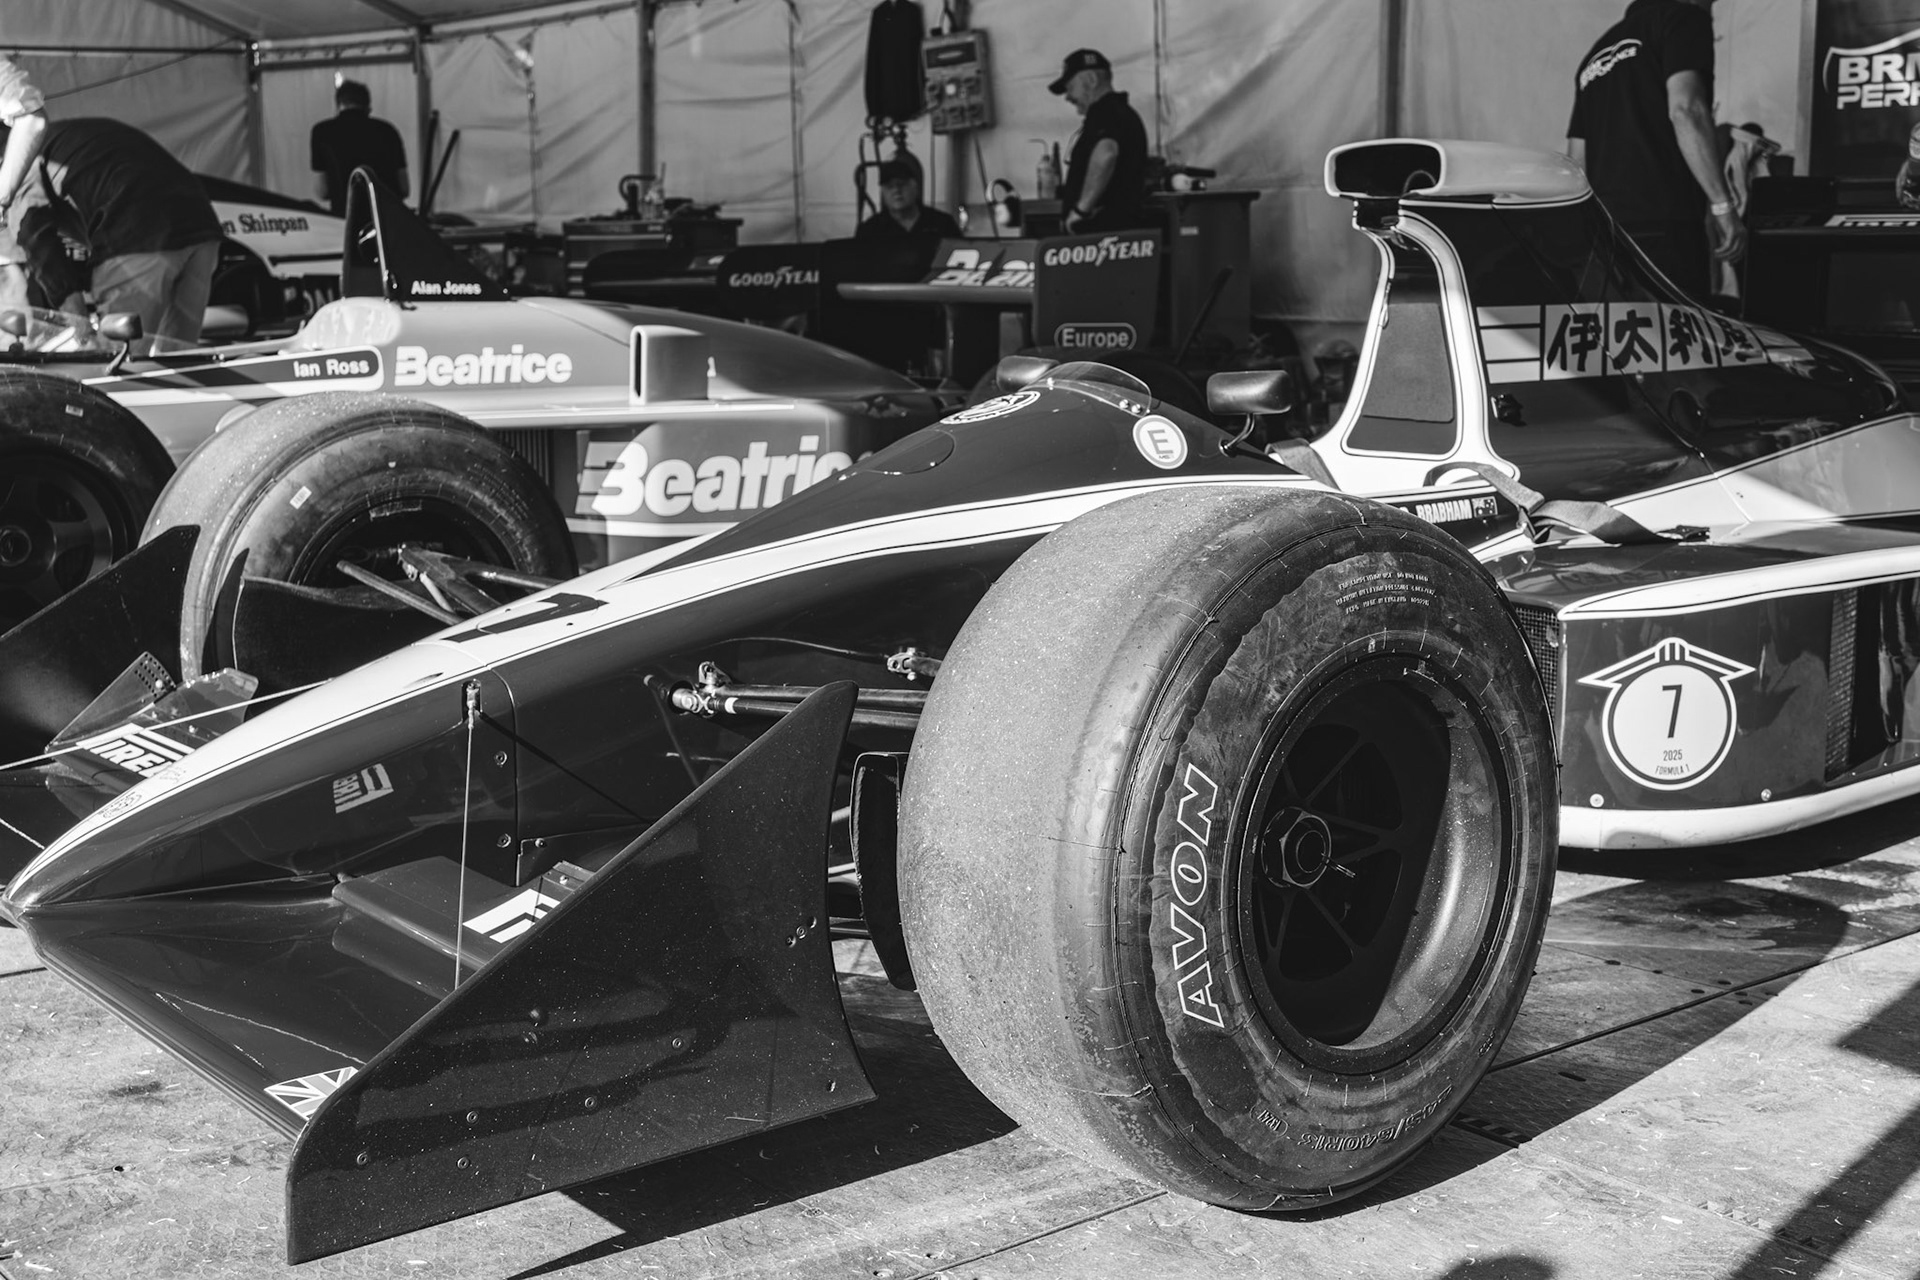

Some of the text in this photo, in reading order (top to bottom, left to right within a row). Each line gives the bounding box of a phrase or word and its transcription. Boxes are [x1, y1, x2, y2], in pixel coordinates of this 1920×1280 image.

[238, 213, 309, 235] Shinpan
[411, 281, 482, 295] Alan Jones
[1062, 327, 1129, 348] Europe
[293, 358, 370, 377] Ian Ross
[395, 344, 573, 387] Beatrice
[1147, 428, 1174, 454] E
[575, 435, 872, 517] Beatric
[1415, 499, 1472, 523] BRABHAM
[1662, 684, 1682, 739] 7
[1663, 749, 1683, 761] 2025
[1655, 763, 1690, 776] FORMULA 1
[1170, 763, 1225, 1028] AVON
